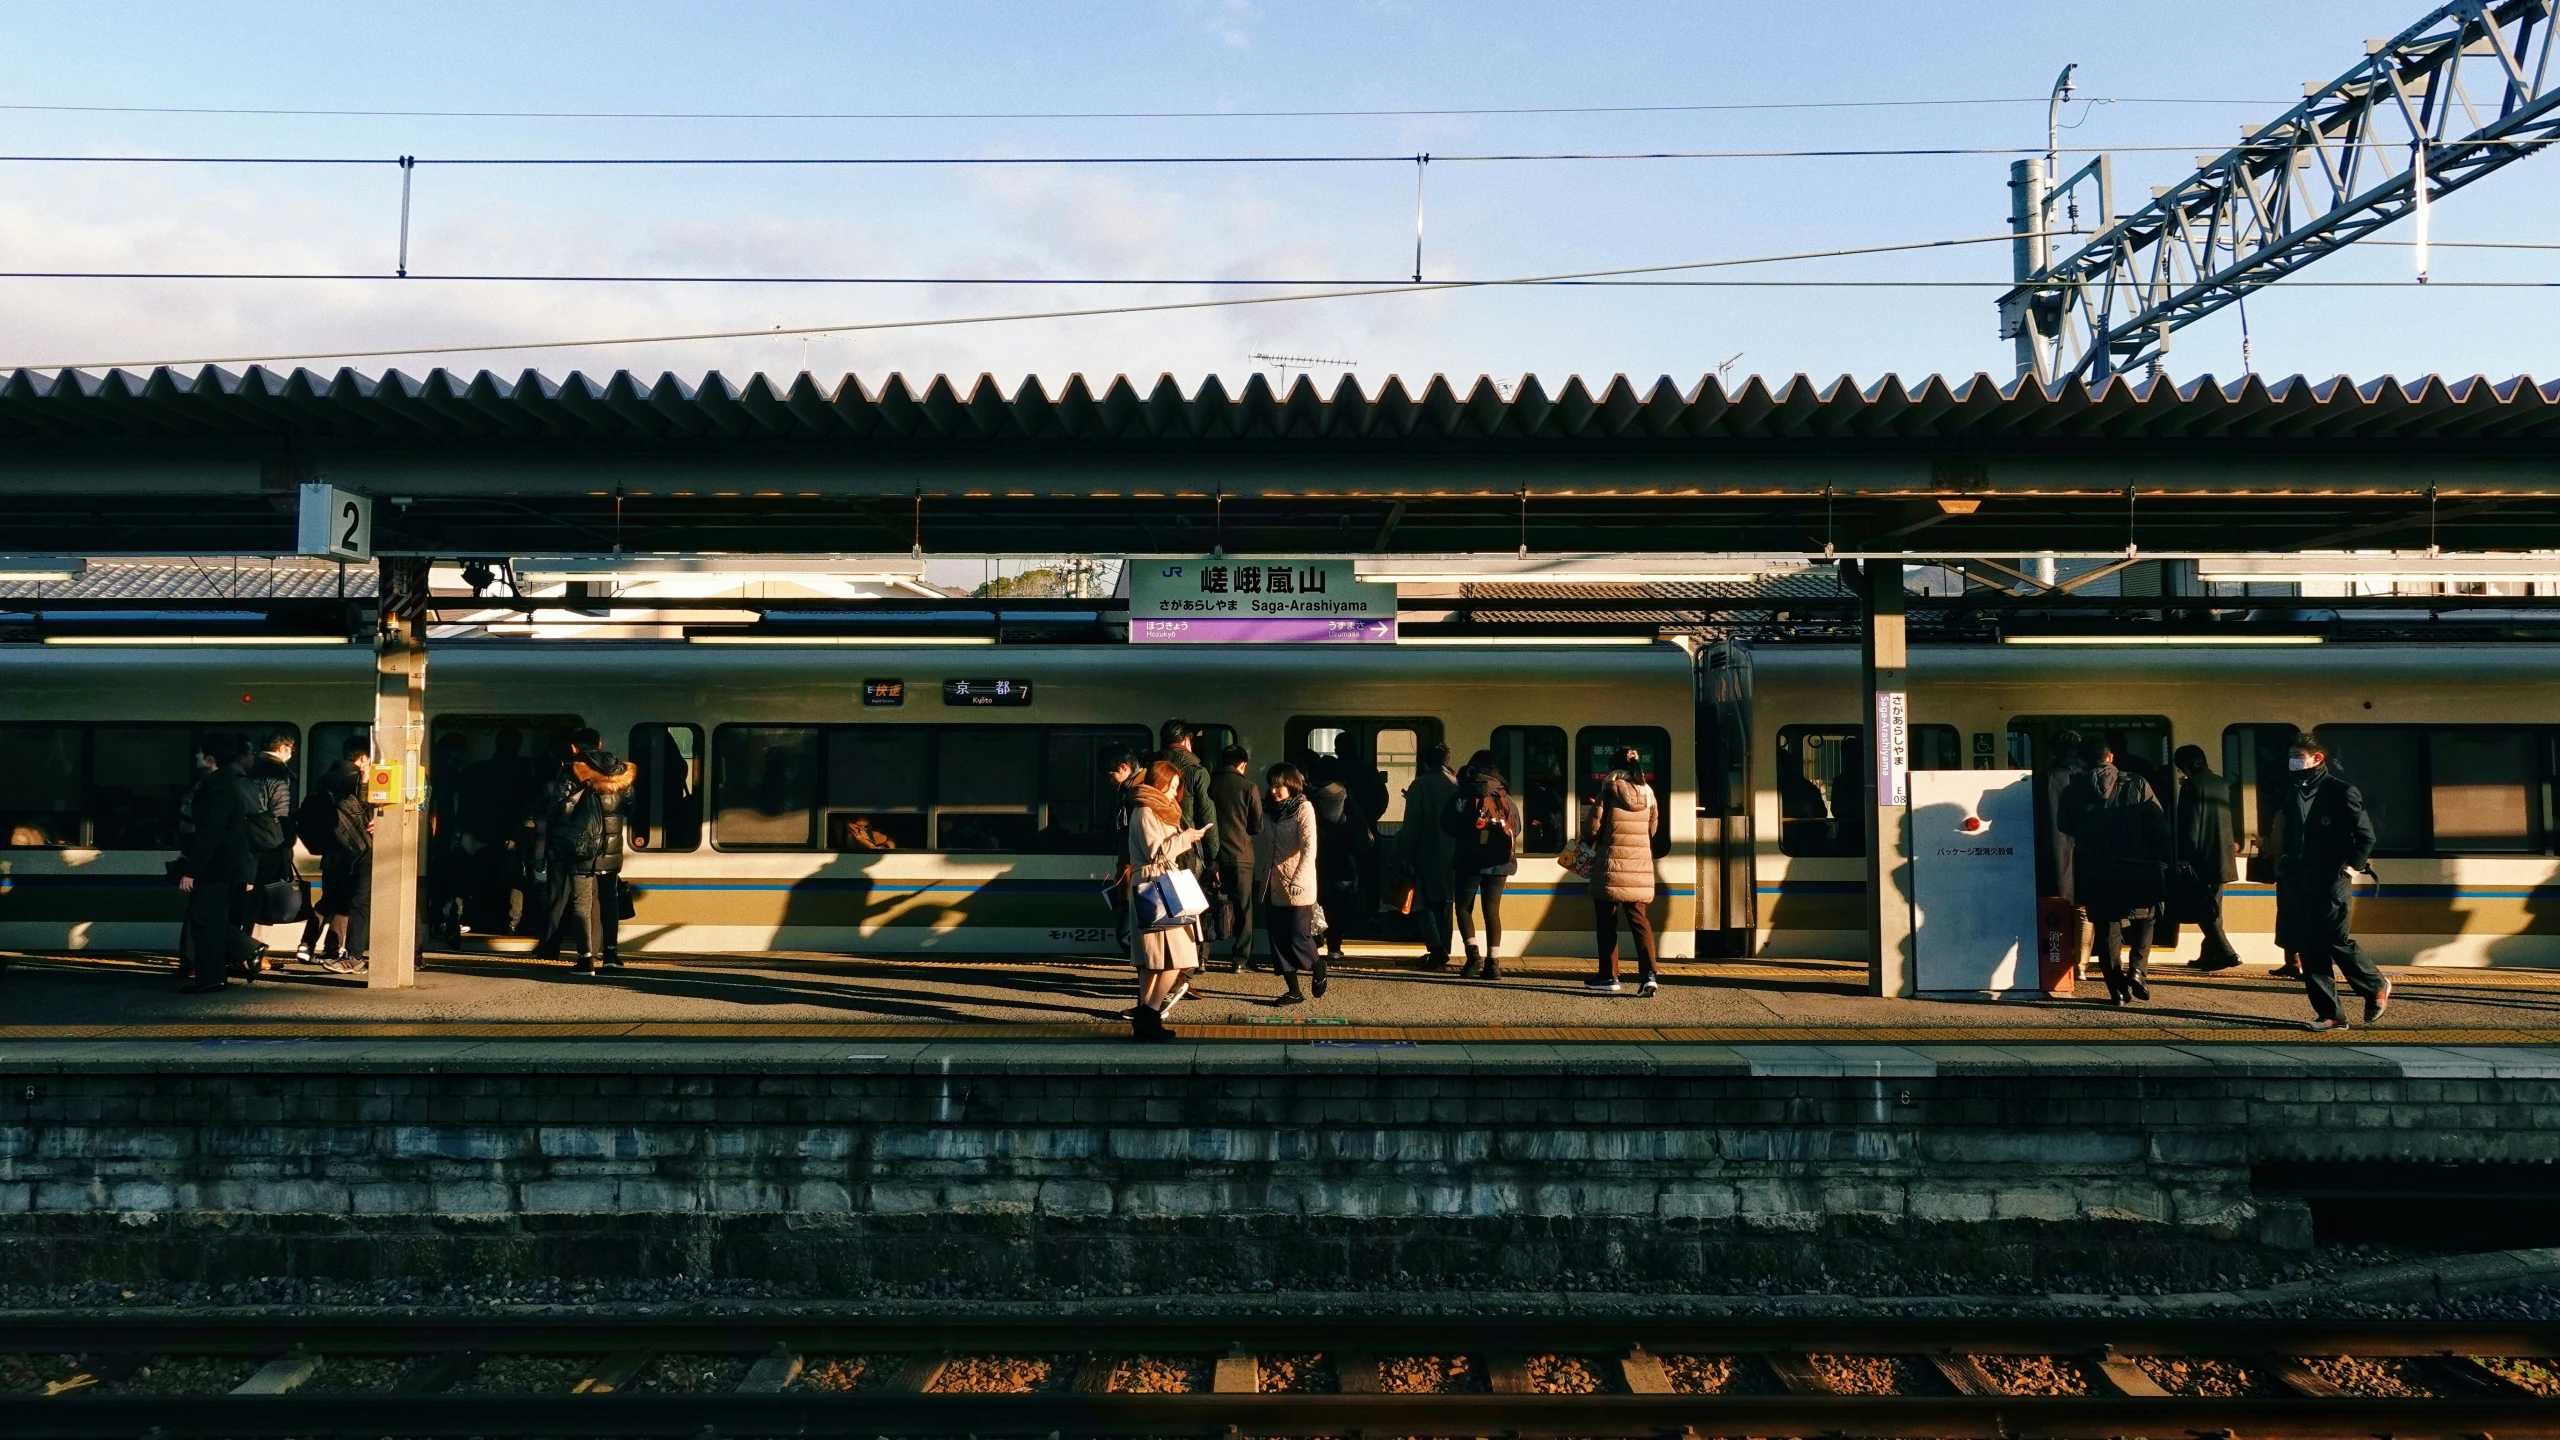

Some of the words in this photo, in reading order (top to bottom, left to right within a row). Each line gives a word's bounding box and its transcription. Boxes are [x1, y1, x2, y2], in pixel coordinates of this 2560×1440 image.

[341, 501, 360, 552] 2
[1162, 566, 1183, 578] JR
[1200, 565, 1327, 594] 嵯峨嵐山
[1159, 600, 1238, 612] さがあらしやま
[1251, 599, 1368, 614] Saga-Arashiyama
[1146, 621, 1189, 632] ほづきょう
[1328, 621, 1366, 632] うずまさ
[1328, 630, 1361, 639] Uzumasa
[955, 680, 1011, 695] 京都
[1018, 686, 1028, 699] 7
[1879, 695, 1891, 776] Saga-Arashiyama
[1892, 695, 1904, 765] さがあらしやま
[1896, 787, 1902, 795] E
[1893, 795, 1907, 804] 08
[2049, 931, 2061, 963] 消火器
